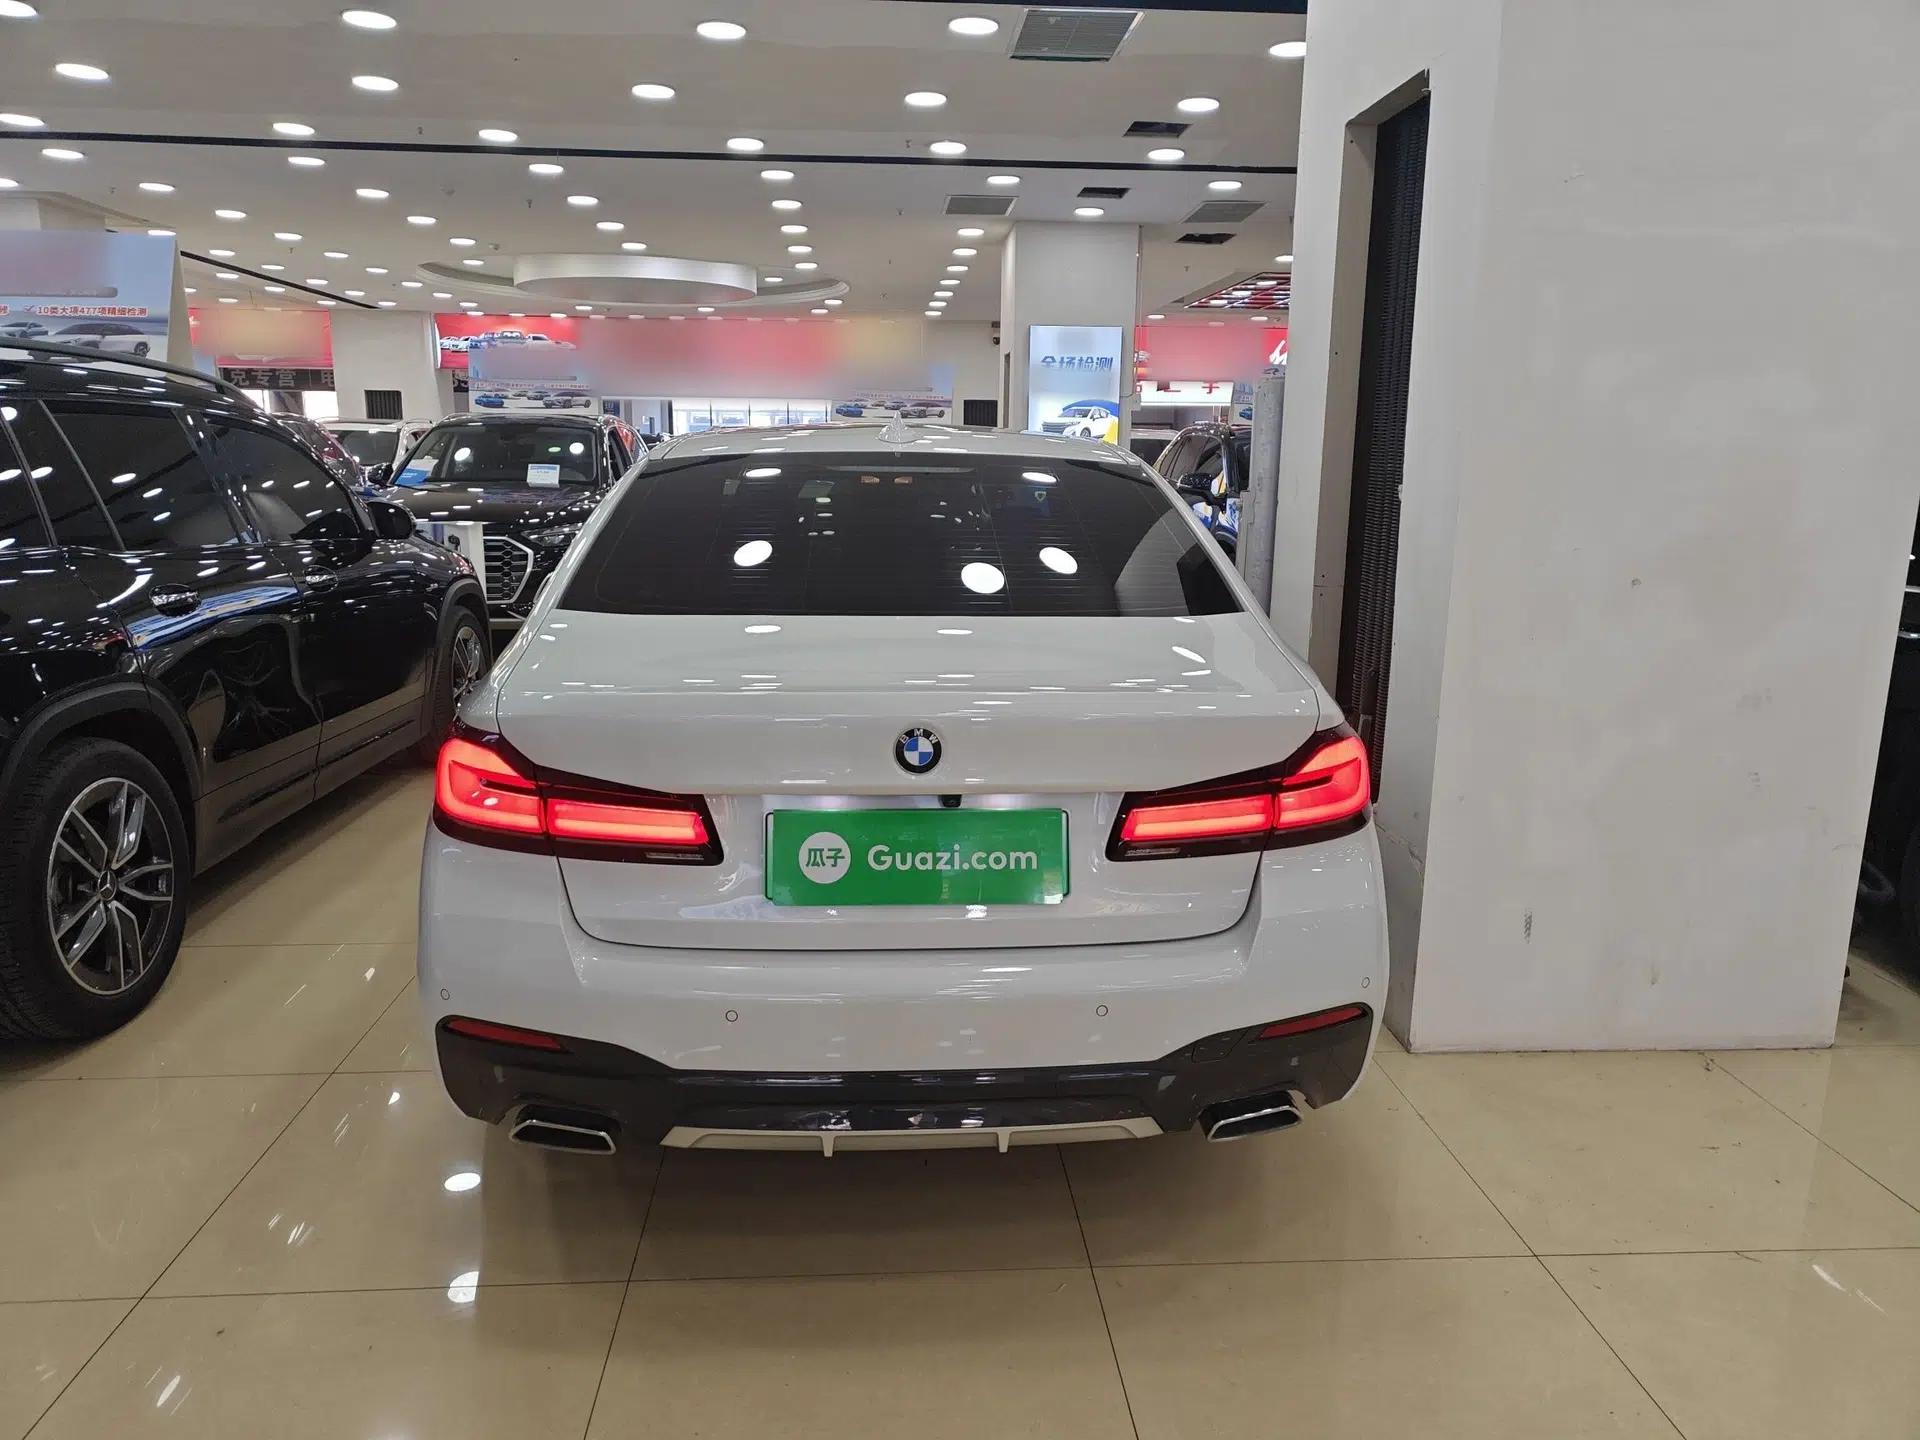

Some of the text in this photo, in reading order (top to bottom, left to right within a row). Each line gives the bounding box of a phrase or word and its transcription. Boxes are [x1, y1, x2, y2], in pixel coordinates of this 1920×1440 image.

[37, 305, 148, 316] 10类大项477项精细检测
[221, 367, 297, 387] 克专营
[899, 728, 939, 744] BMW
[805, 848, 846, 868] 瓜子
[867, 844, 1038, 871] Guazi.com
